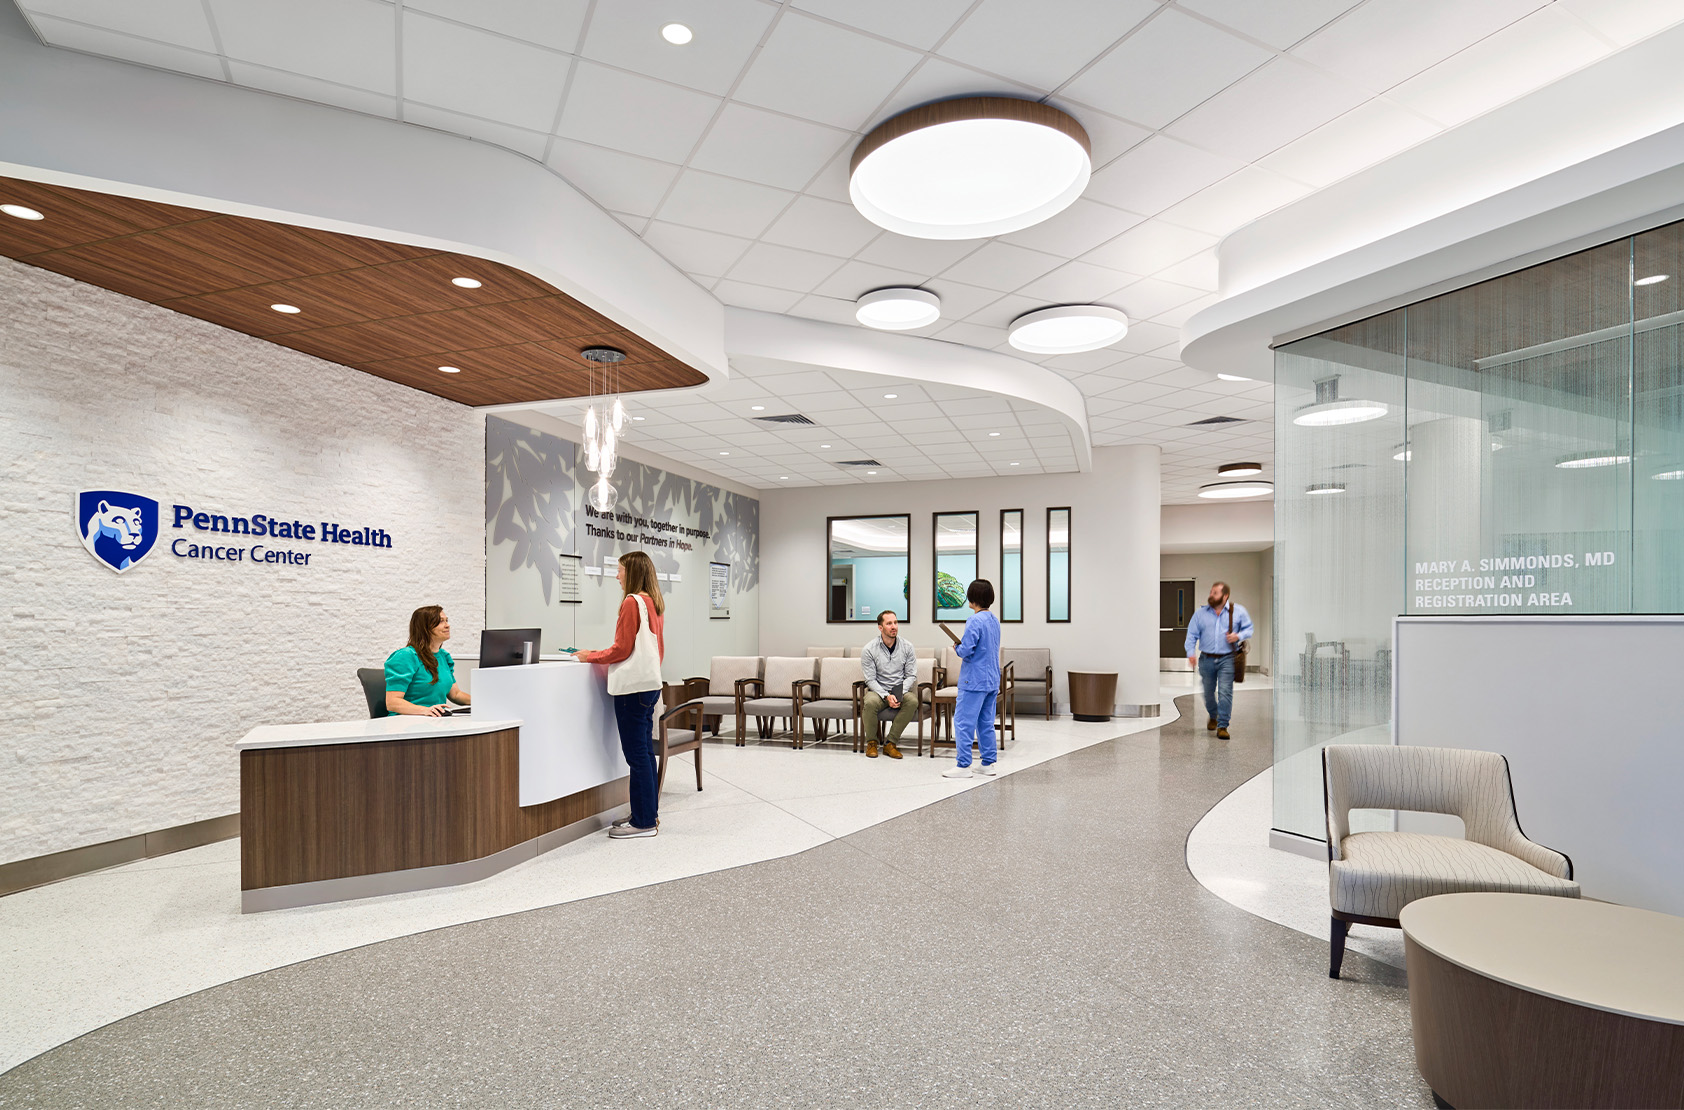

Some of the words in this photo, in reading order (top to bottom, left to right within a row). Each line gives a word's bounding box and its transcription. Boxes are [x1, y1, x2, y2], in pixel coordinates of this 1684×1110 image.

[172, 504, 316, 540] PennState
[320, 522, 393, 548] Health
[585, 504, 599, 518] We
[601, 510, 614, 521] are
[616, 512, 632, 524] with
[634, 516, 649, 529] you,
[650, 519, 678, 533] together
[679, 524, 685, 534] in
[686, 528, 711, 539] purpose.
[585, 523, 615, 539] Thanks
[616, 529, 625, 541] to
[626, 533, 638, 542] our
[640, 533, 668, 547] Partners
[669, 537, 675, 549] in
[675, 539, 693, 552] Hope.
[171, 538, 245, 561] Cancer
[250, 545, 312, 565] Center
[1415, 560, 1457, 574] MARY
[1461, 560, 1475, 572] A.
[1480, 553, 1580, 572] SIMMONDS,
[1585, 551, 1615, 566] MD
[1415, 576, 1495, 591] RECEPTION
[1500, 574, 1535, 589] AND
[1415, 593, 1523, 608] REGISTRATION
[1527, 592, 1573, 607] AREA
